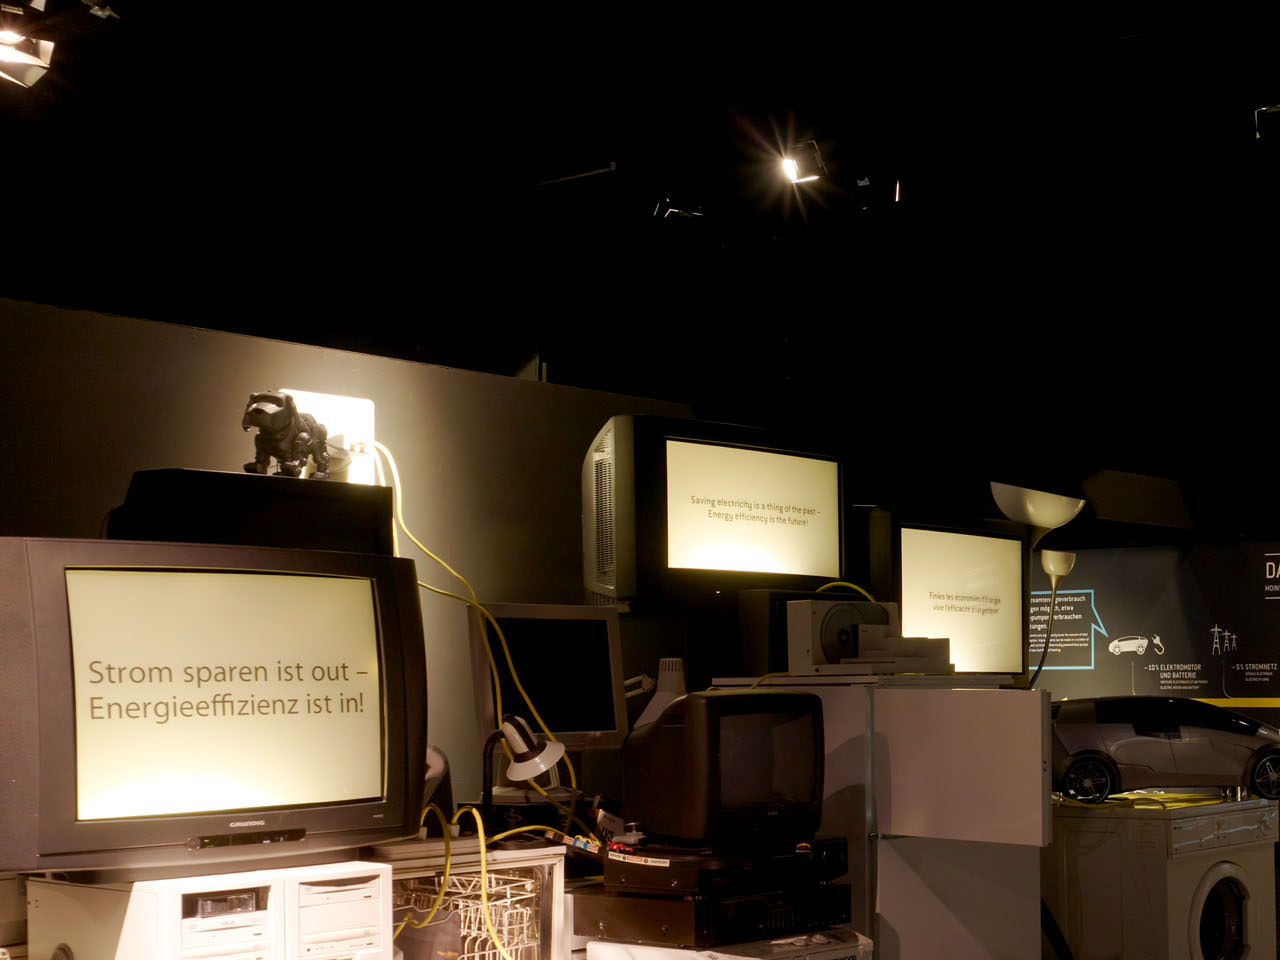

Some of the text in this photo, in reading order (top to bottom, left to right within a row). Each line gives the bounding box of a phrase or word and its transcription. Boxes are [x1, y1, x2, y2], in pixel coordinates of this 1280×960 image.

[88, 660, 172, 684] Strom
[183, 665, 267, 688] sparen
[277, 660, 303, 681] ist
[311, 663, 349, 681] out
[90, 691, 363, 724] Energieeffizienz ist in!
[229, 820, 266, 828] GRUNDIG
